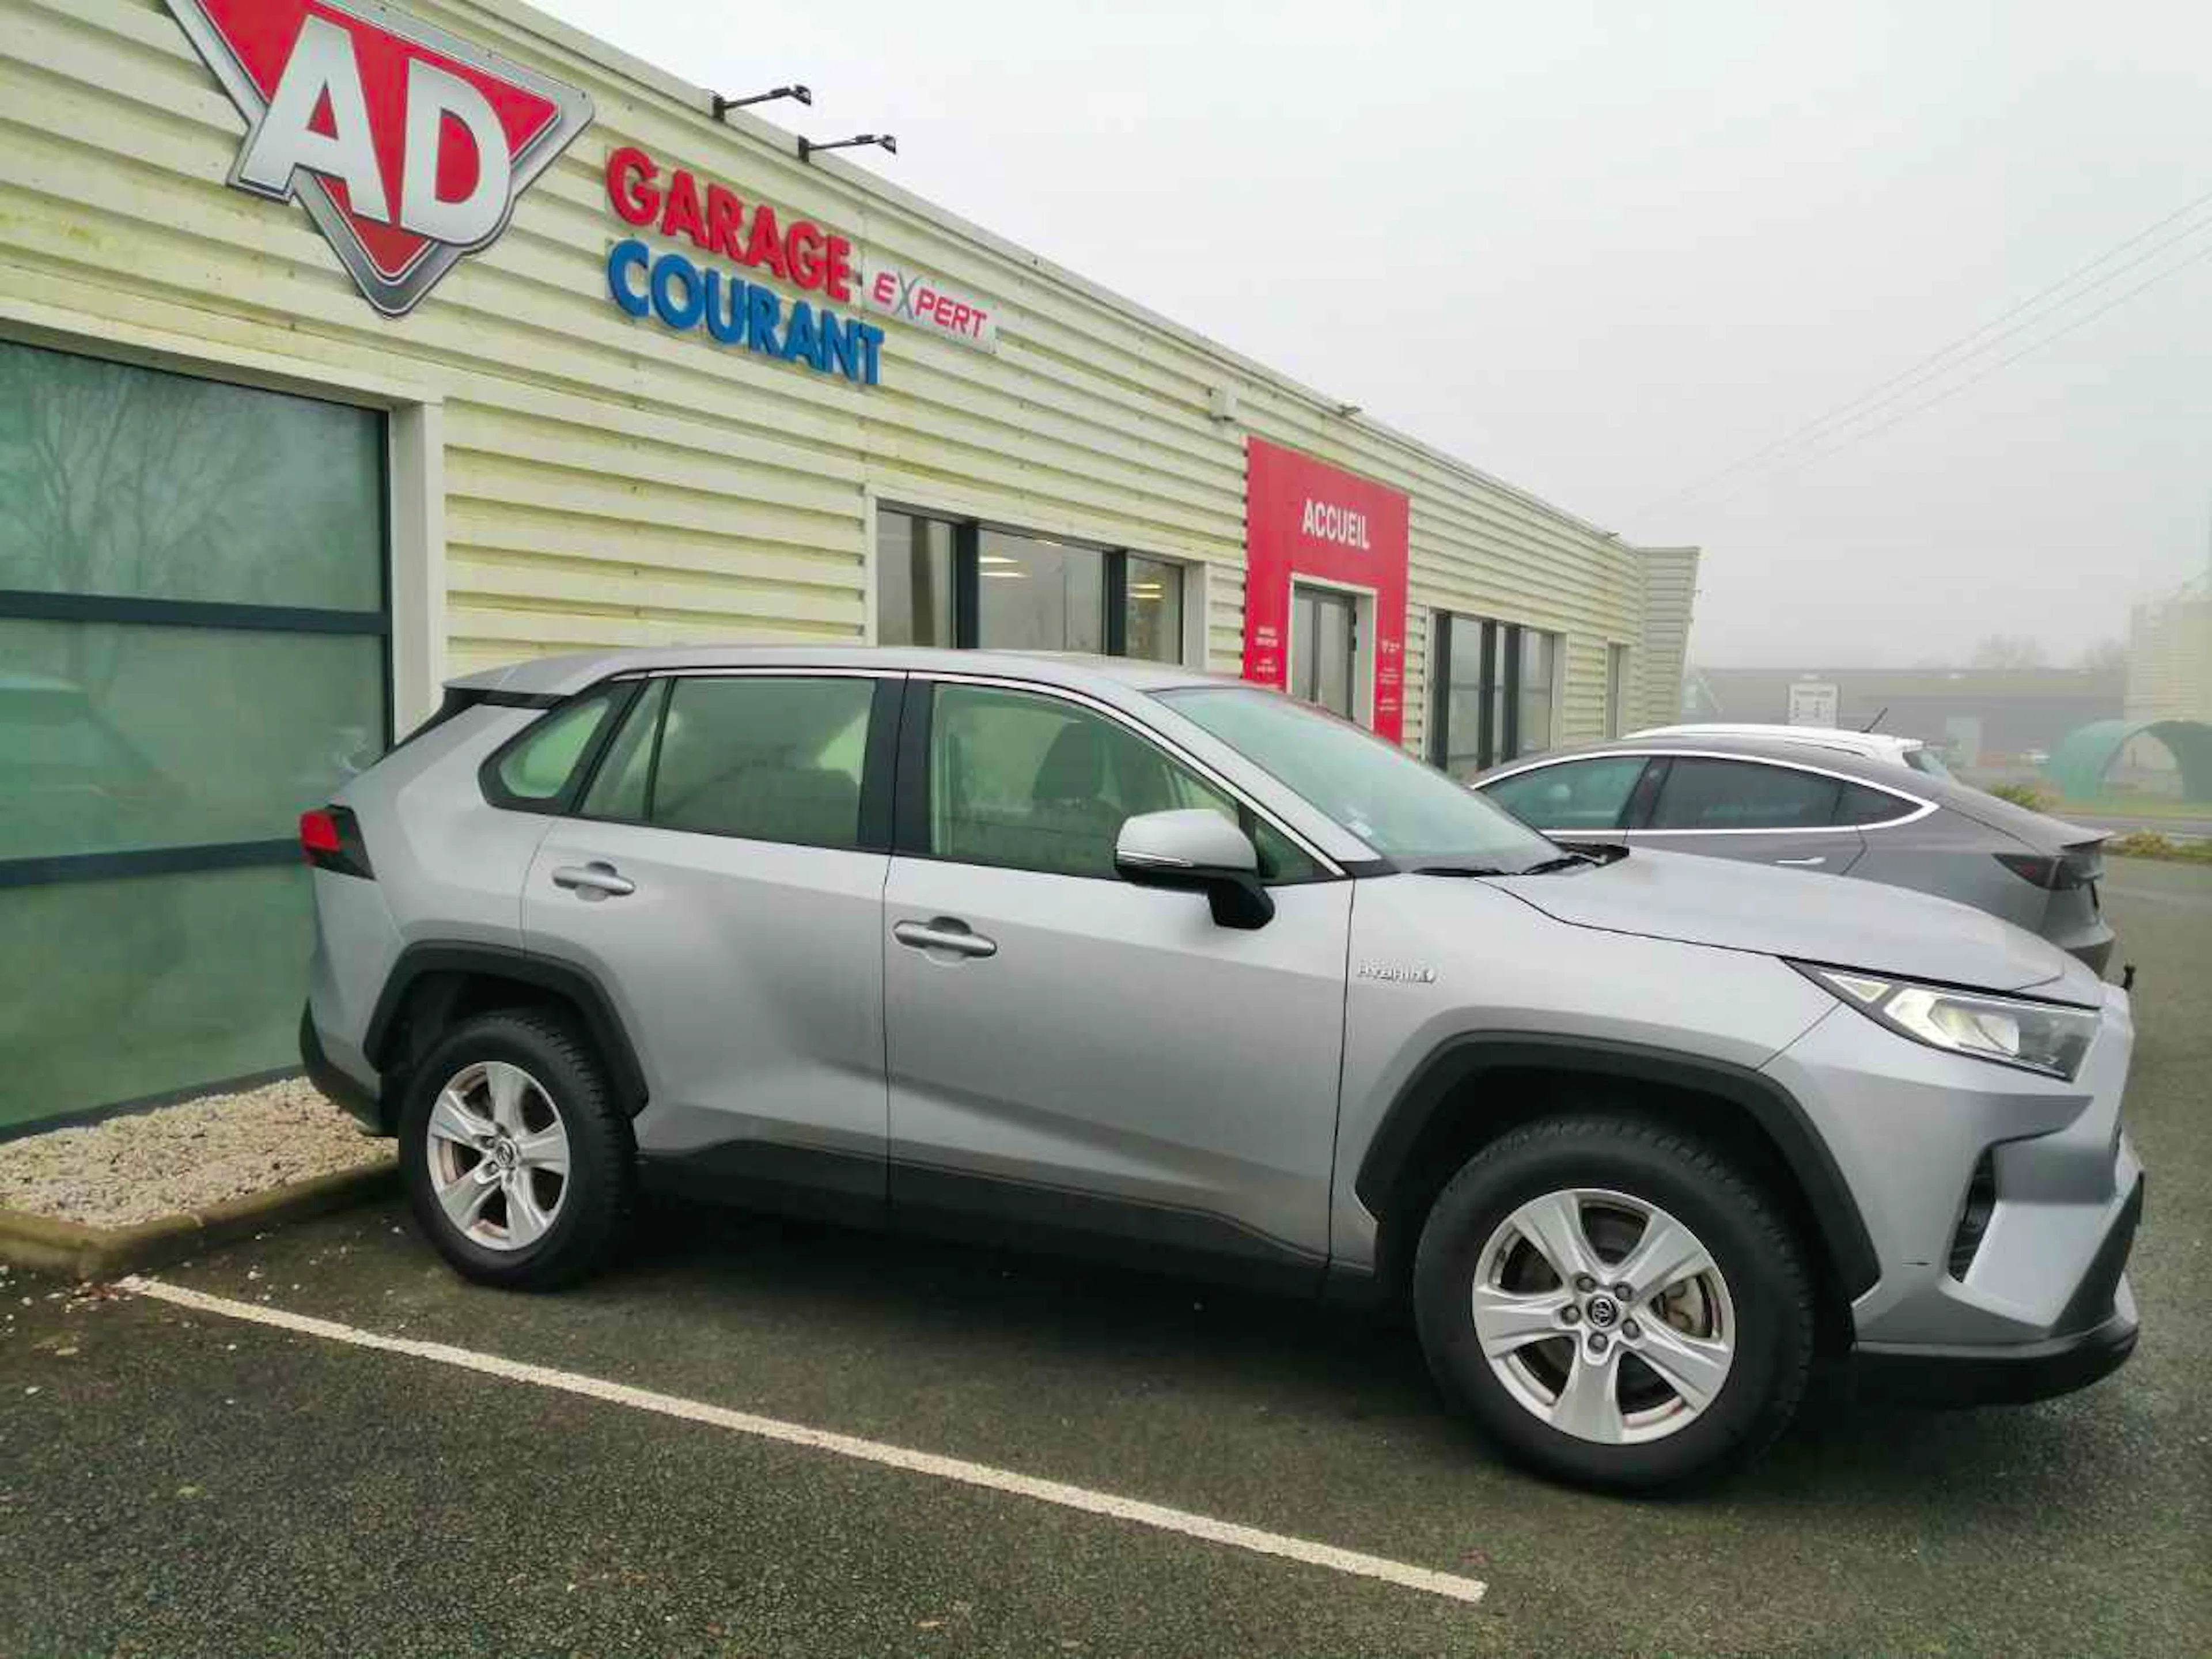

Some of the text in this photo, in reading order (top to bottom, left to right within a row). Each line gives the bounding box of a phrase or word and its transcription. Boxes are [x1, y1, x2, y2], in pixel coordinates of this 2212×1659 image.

[236, 14, 512, 246] AD
[606, 146, 854, 304] GARAGE
[608, 238, 885, 386] COURANT
[872, 270, 987, 339] EXPERT
[1302, 498, 1370, 550] ACCUEIL
